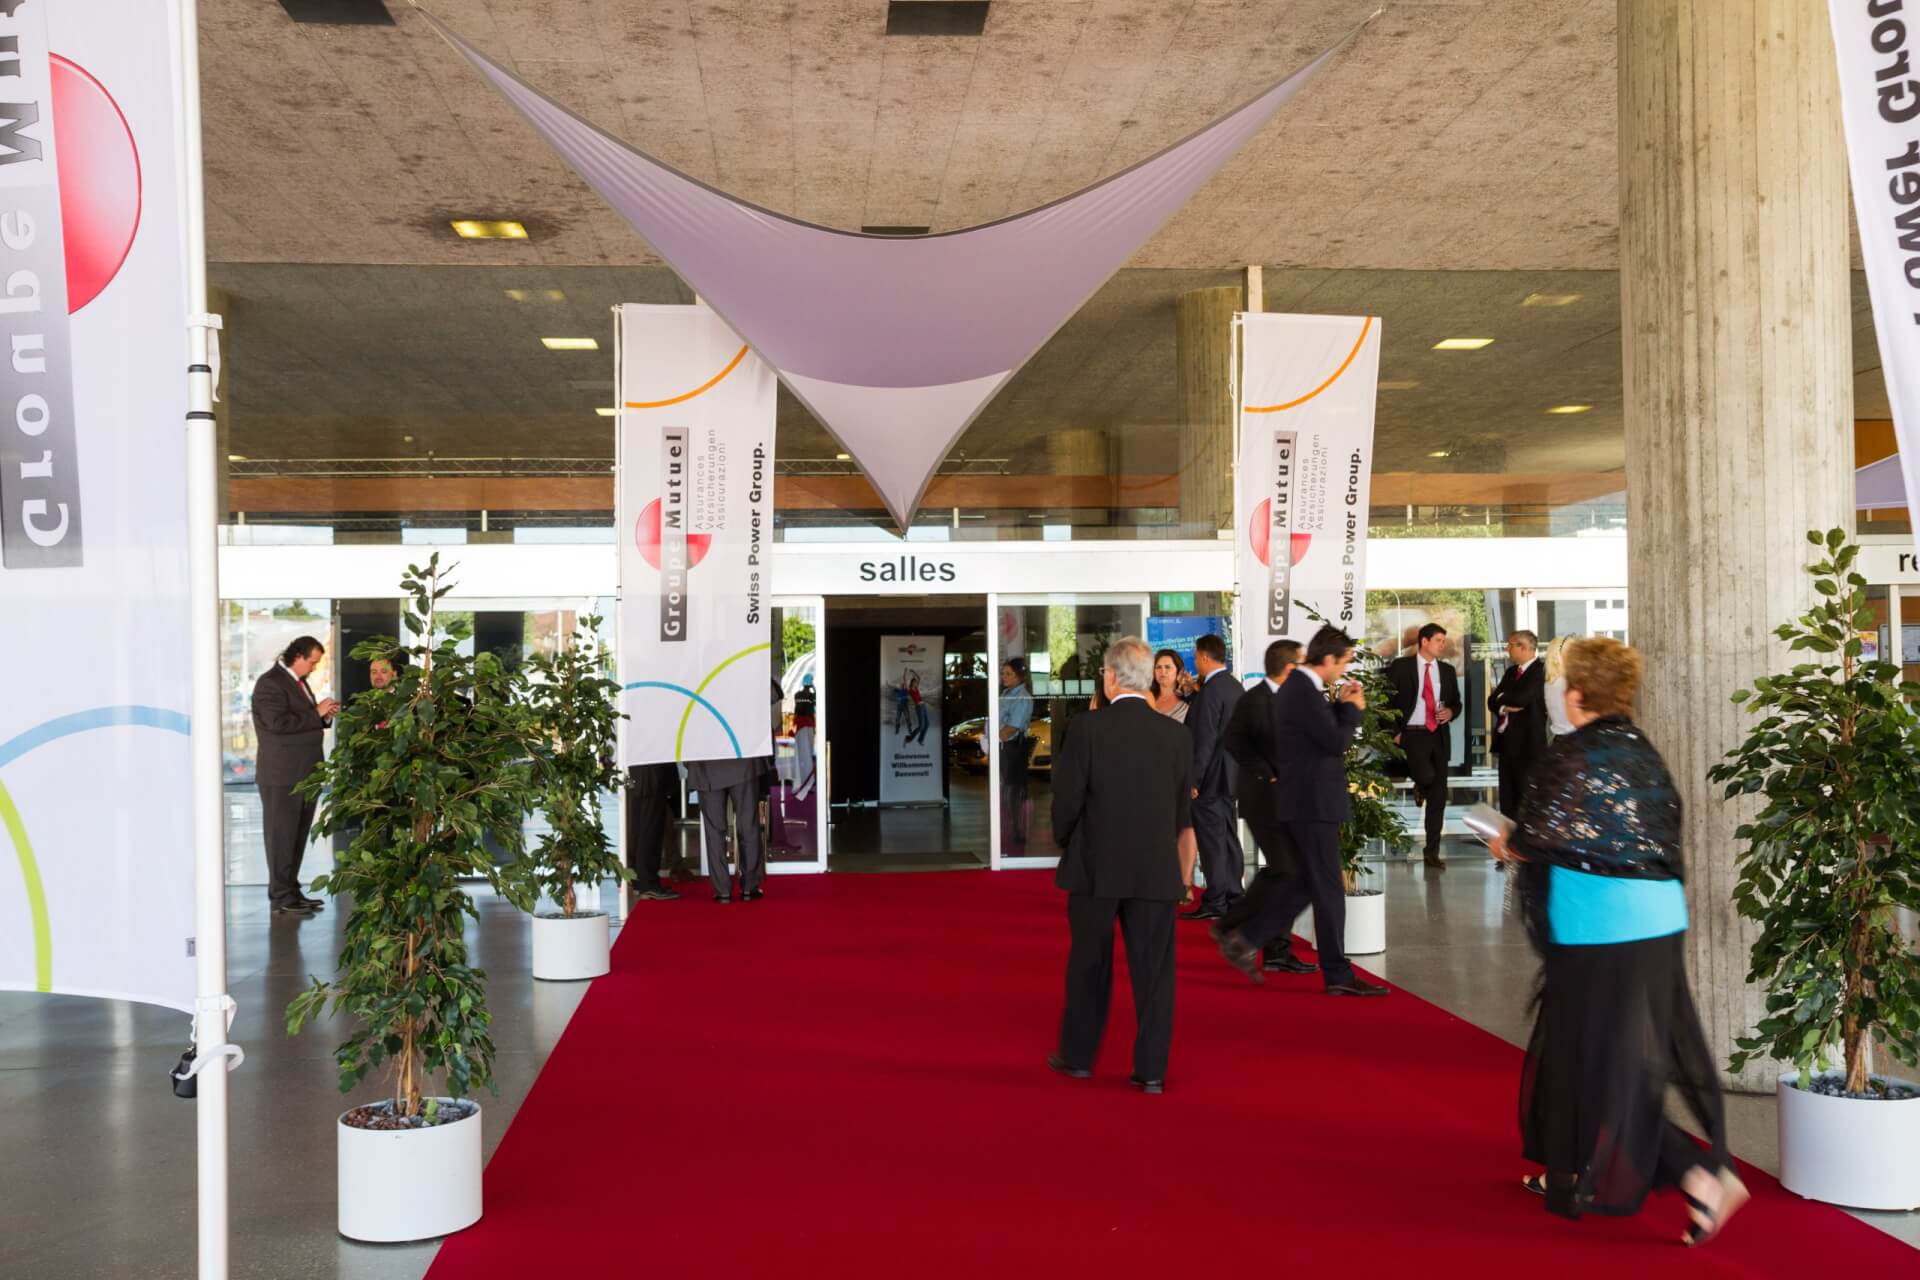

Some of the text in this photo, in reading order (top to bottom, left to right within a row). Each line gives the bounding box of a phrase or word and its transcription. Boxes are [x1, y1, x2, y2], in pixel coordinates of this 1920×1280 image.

[695, 455, 705, 530] Assurances
[705, 429, 717, 530] Versicherungen
[716, 442, 726, 530] Assicurazioni
[1298, 458, 1310, 529] Assurances
[664, 434, 686, 636] Groupe Mutuel
[747, 442, 766, 624] Swiss Power Group.
[859, 555, 956, 582] salles
[1270, 437, 1291, 630] Groupe Mutuel
[1340, 448, 1362, 621] Swiss Power Group.
